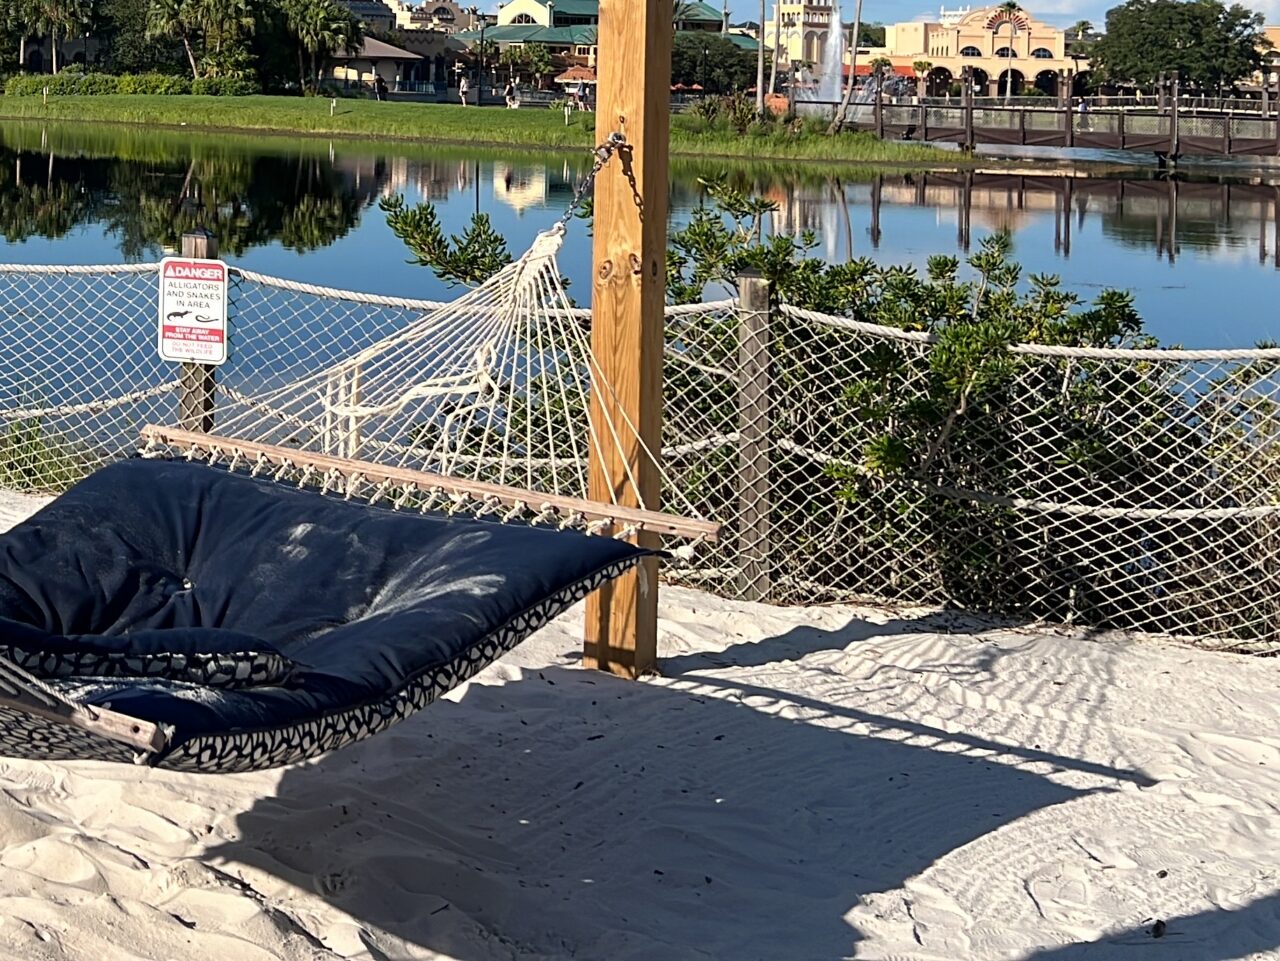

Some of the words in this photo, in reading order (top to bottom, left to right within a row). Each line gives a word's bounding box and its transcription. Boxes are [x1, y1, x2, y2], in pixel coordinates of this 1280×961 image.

[175, 266, 223, 280] DANGER
[168, 281, 220, 291] ALLIGATORS
[166, 290, 185, 298] AND
[186, 291, 221, 301] SNAKES
[187, 300, 211, 309] AREA
